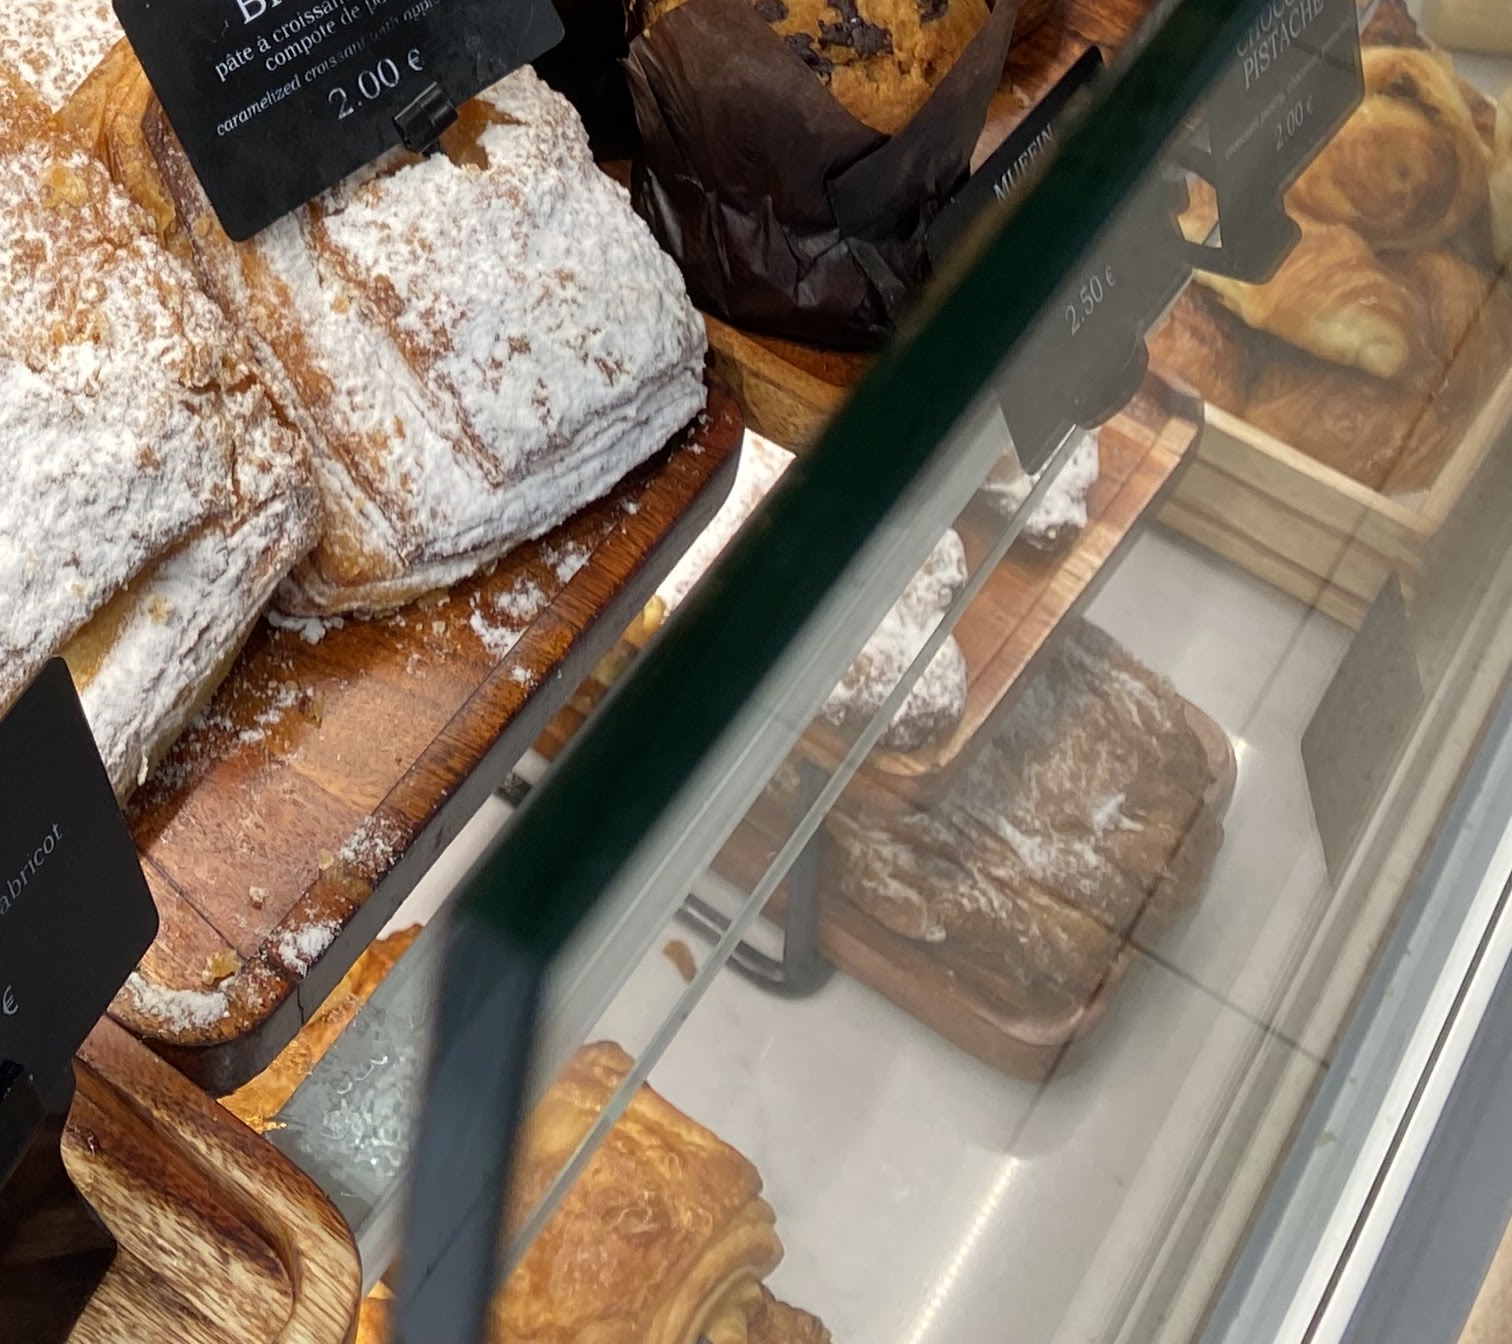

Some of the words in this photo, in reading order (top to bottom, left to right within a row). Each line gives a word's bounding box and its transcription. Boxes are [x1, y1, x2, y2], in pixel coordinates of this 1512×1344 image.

[215, 48, 255, 83] pâte
[256, 35, 272, 53] à
[264, 20, 338, 73] compote
[340, 6, 361, 28] de
[216, 74, 302, 137] caramelized
[303, 37, 367, 85] croissant
[327, 57, 400, 121] 2.00
[406, 48, 424, 73] €
[1275, 102, 1304, 151] 2.00
[1063, 273, 1105, 338] 2.50
[1103, 264, 1117, 289] €
[3, 984, 21, 1018] €
